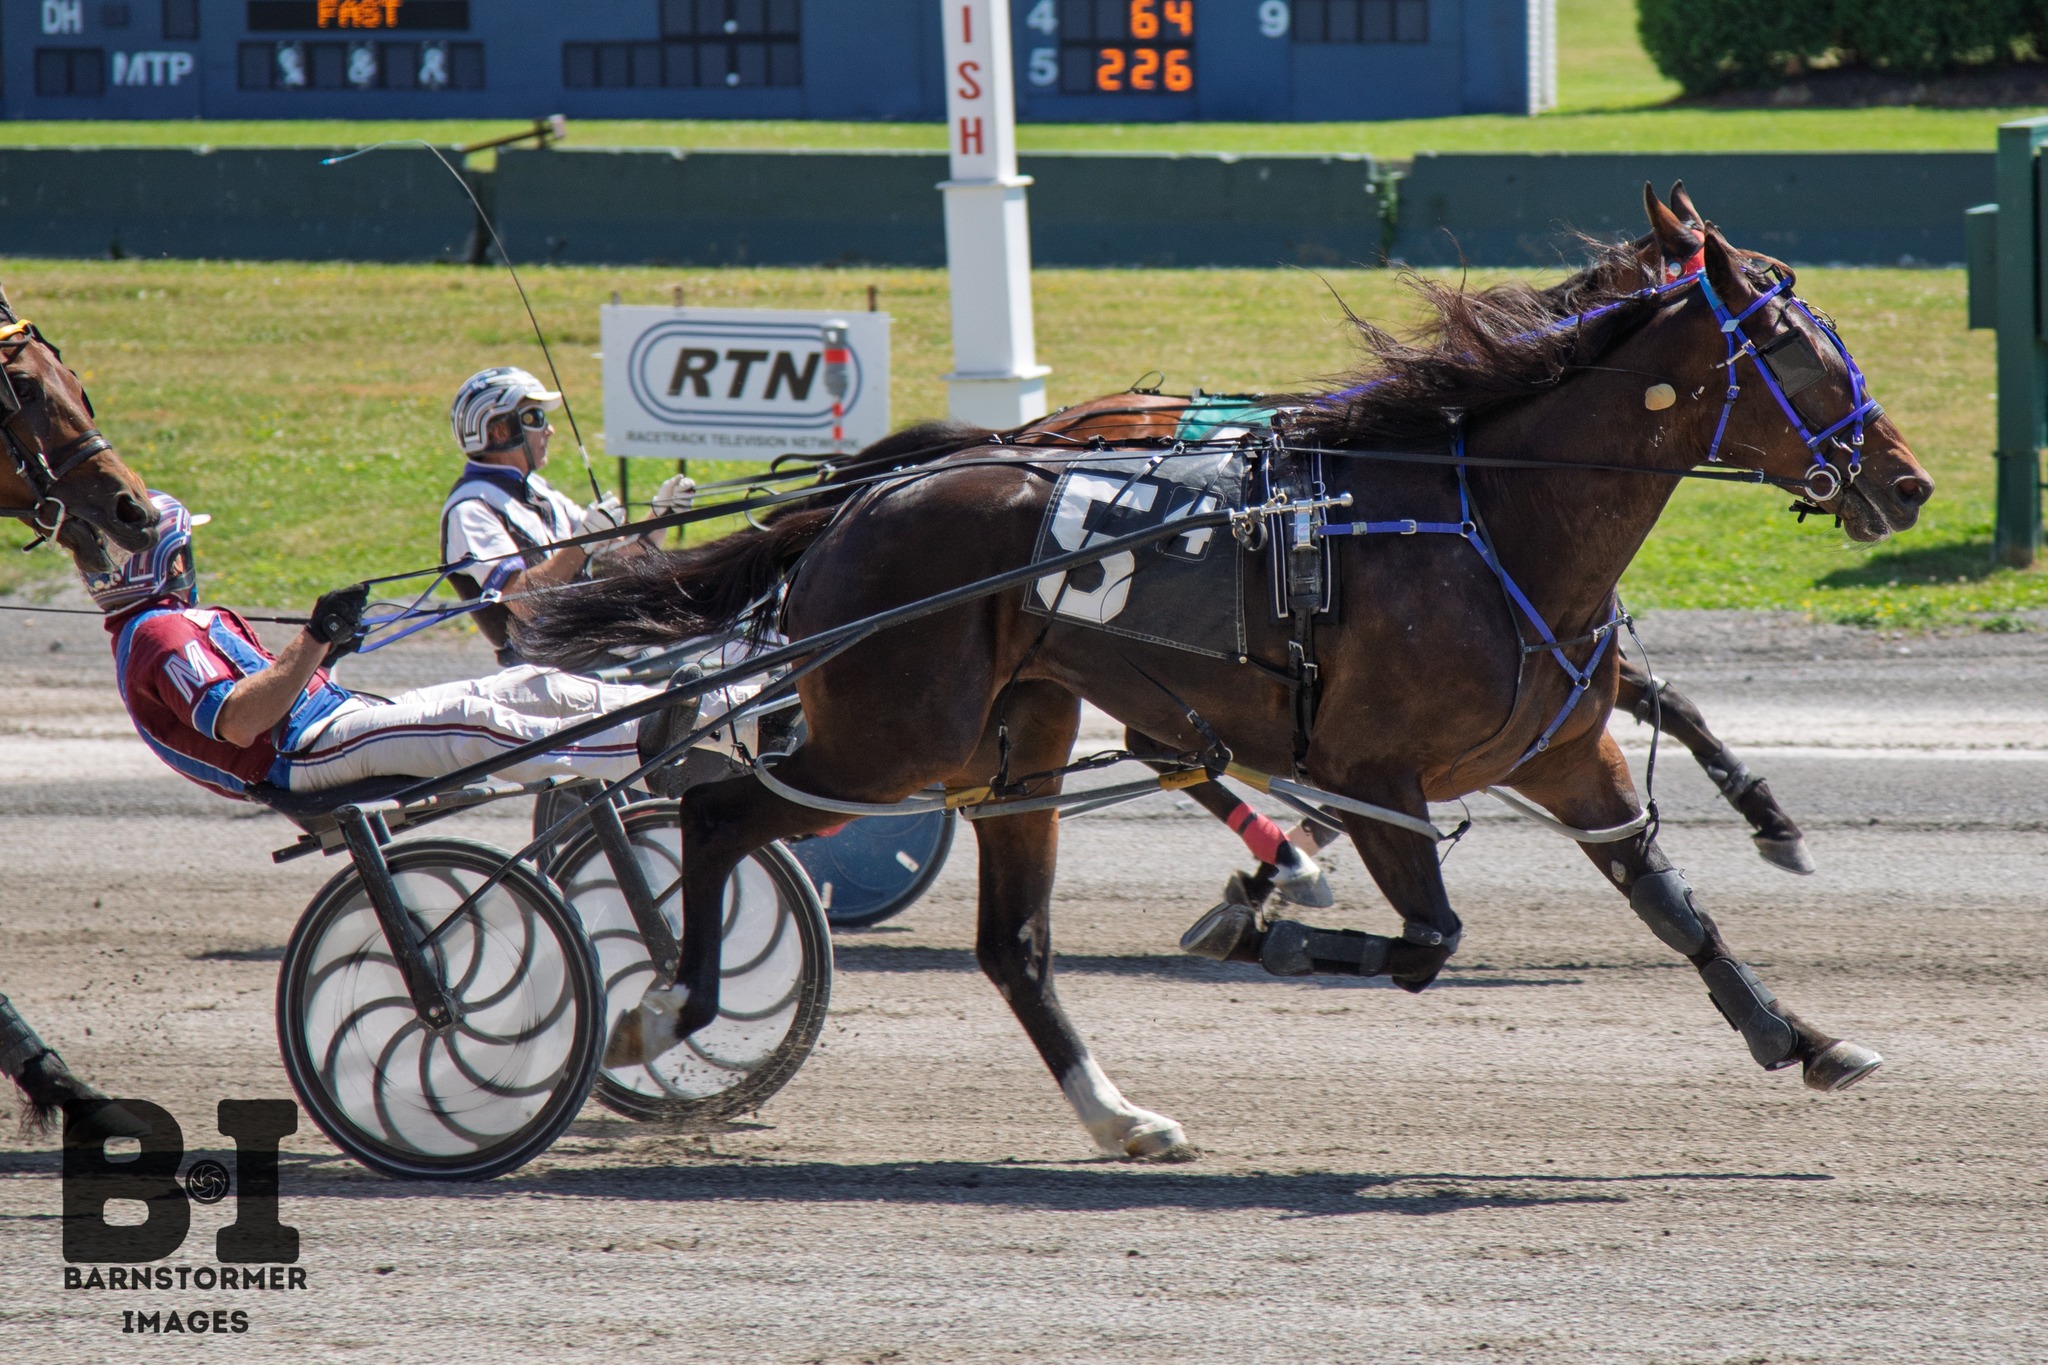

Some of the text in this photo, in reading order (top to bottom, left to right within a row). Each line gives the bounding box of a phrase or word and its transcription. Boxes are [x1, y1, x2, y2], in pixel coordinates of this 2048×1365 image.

[42, 0, 83, 34] DH
[316, 0, 402, 28] FAST
[1026, 0, 1194, 39] 4 64
[1258, 0, 1291, 37] 9
[112, 51, 194, 86] MTP
[1028, 48, 1194, 92] 5 226
[666, 347, 822, 401] RTN
[625, 430, 859, 449] RACETRACK TELEVISION NETWRK
[163, 638, 218, 705] M
